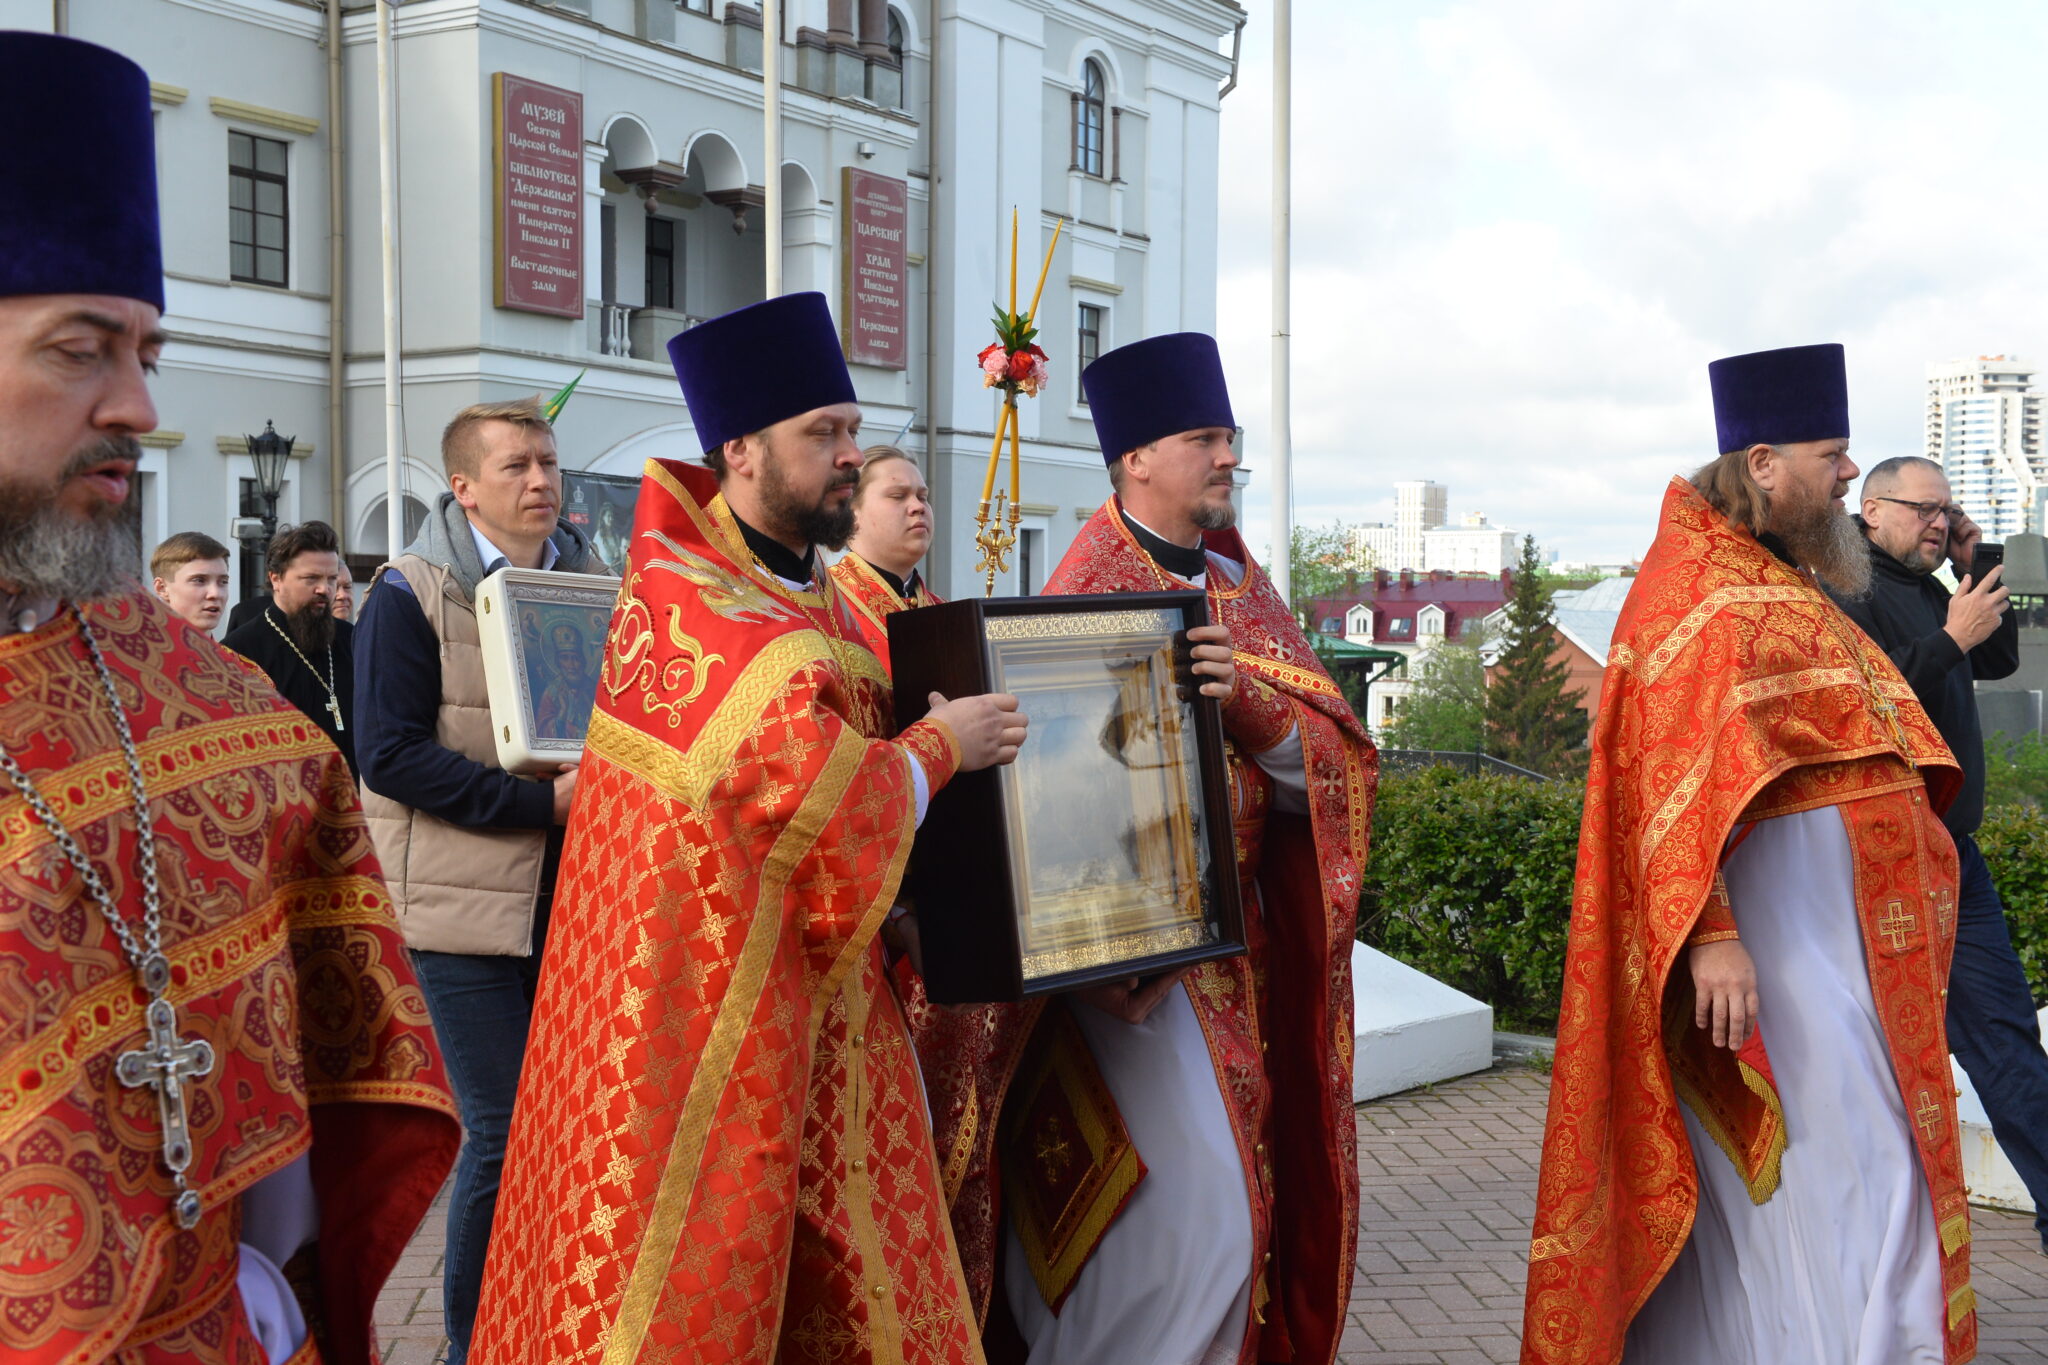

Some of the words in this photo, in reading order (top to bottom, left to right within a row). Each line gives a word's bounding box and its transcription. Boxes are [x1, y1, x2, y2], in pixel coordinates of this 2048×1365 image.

[521, 102, 566, 124] МУЗЕЙ
[527, 121, 561, 139] Святой
[509, 132, 546, 151] Царской
[549, 142, 578, 159] Семьи
[510, 161, 577, 186] БИБЛИОТЕКА
[511, 178, 577, 203] "Державная"
[511, 199, 539, 212] имени
[543, 205, 577, 220] святого
[518, 213, 573, 236] Императора
[855, 218, 902, 242] "ЦАРСКИЙ"
[521, 229, 559, 247] Николая
[562, 237, 570, 249] II
[511, 255, 578, 279] Выставочные
[865, 253, 891, 269] ХРАМ
[860, 266, 898, 282] святителя
[532, 280, 557, 293] залы
[857, 292, 899, 308] чудотворца
[860, 317, 898, 334] Церковная
